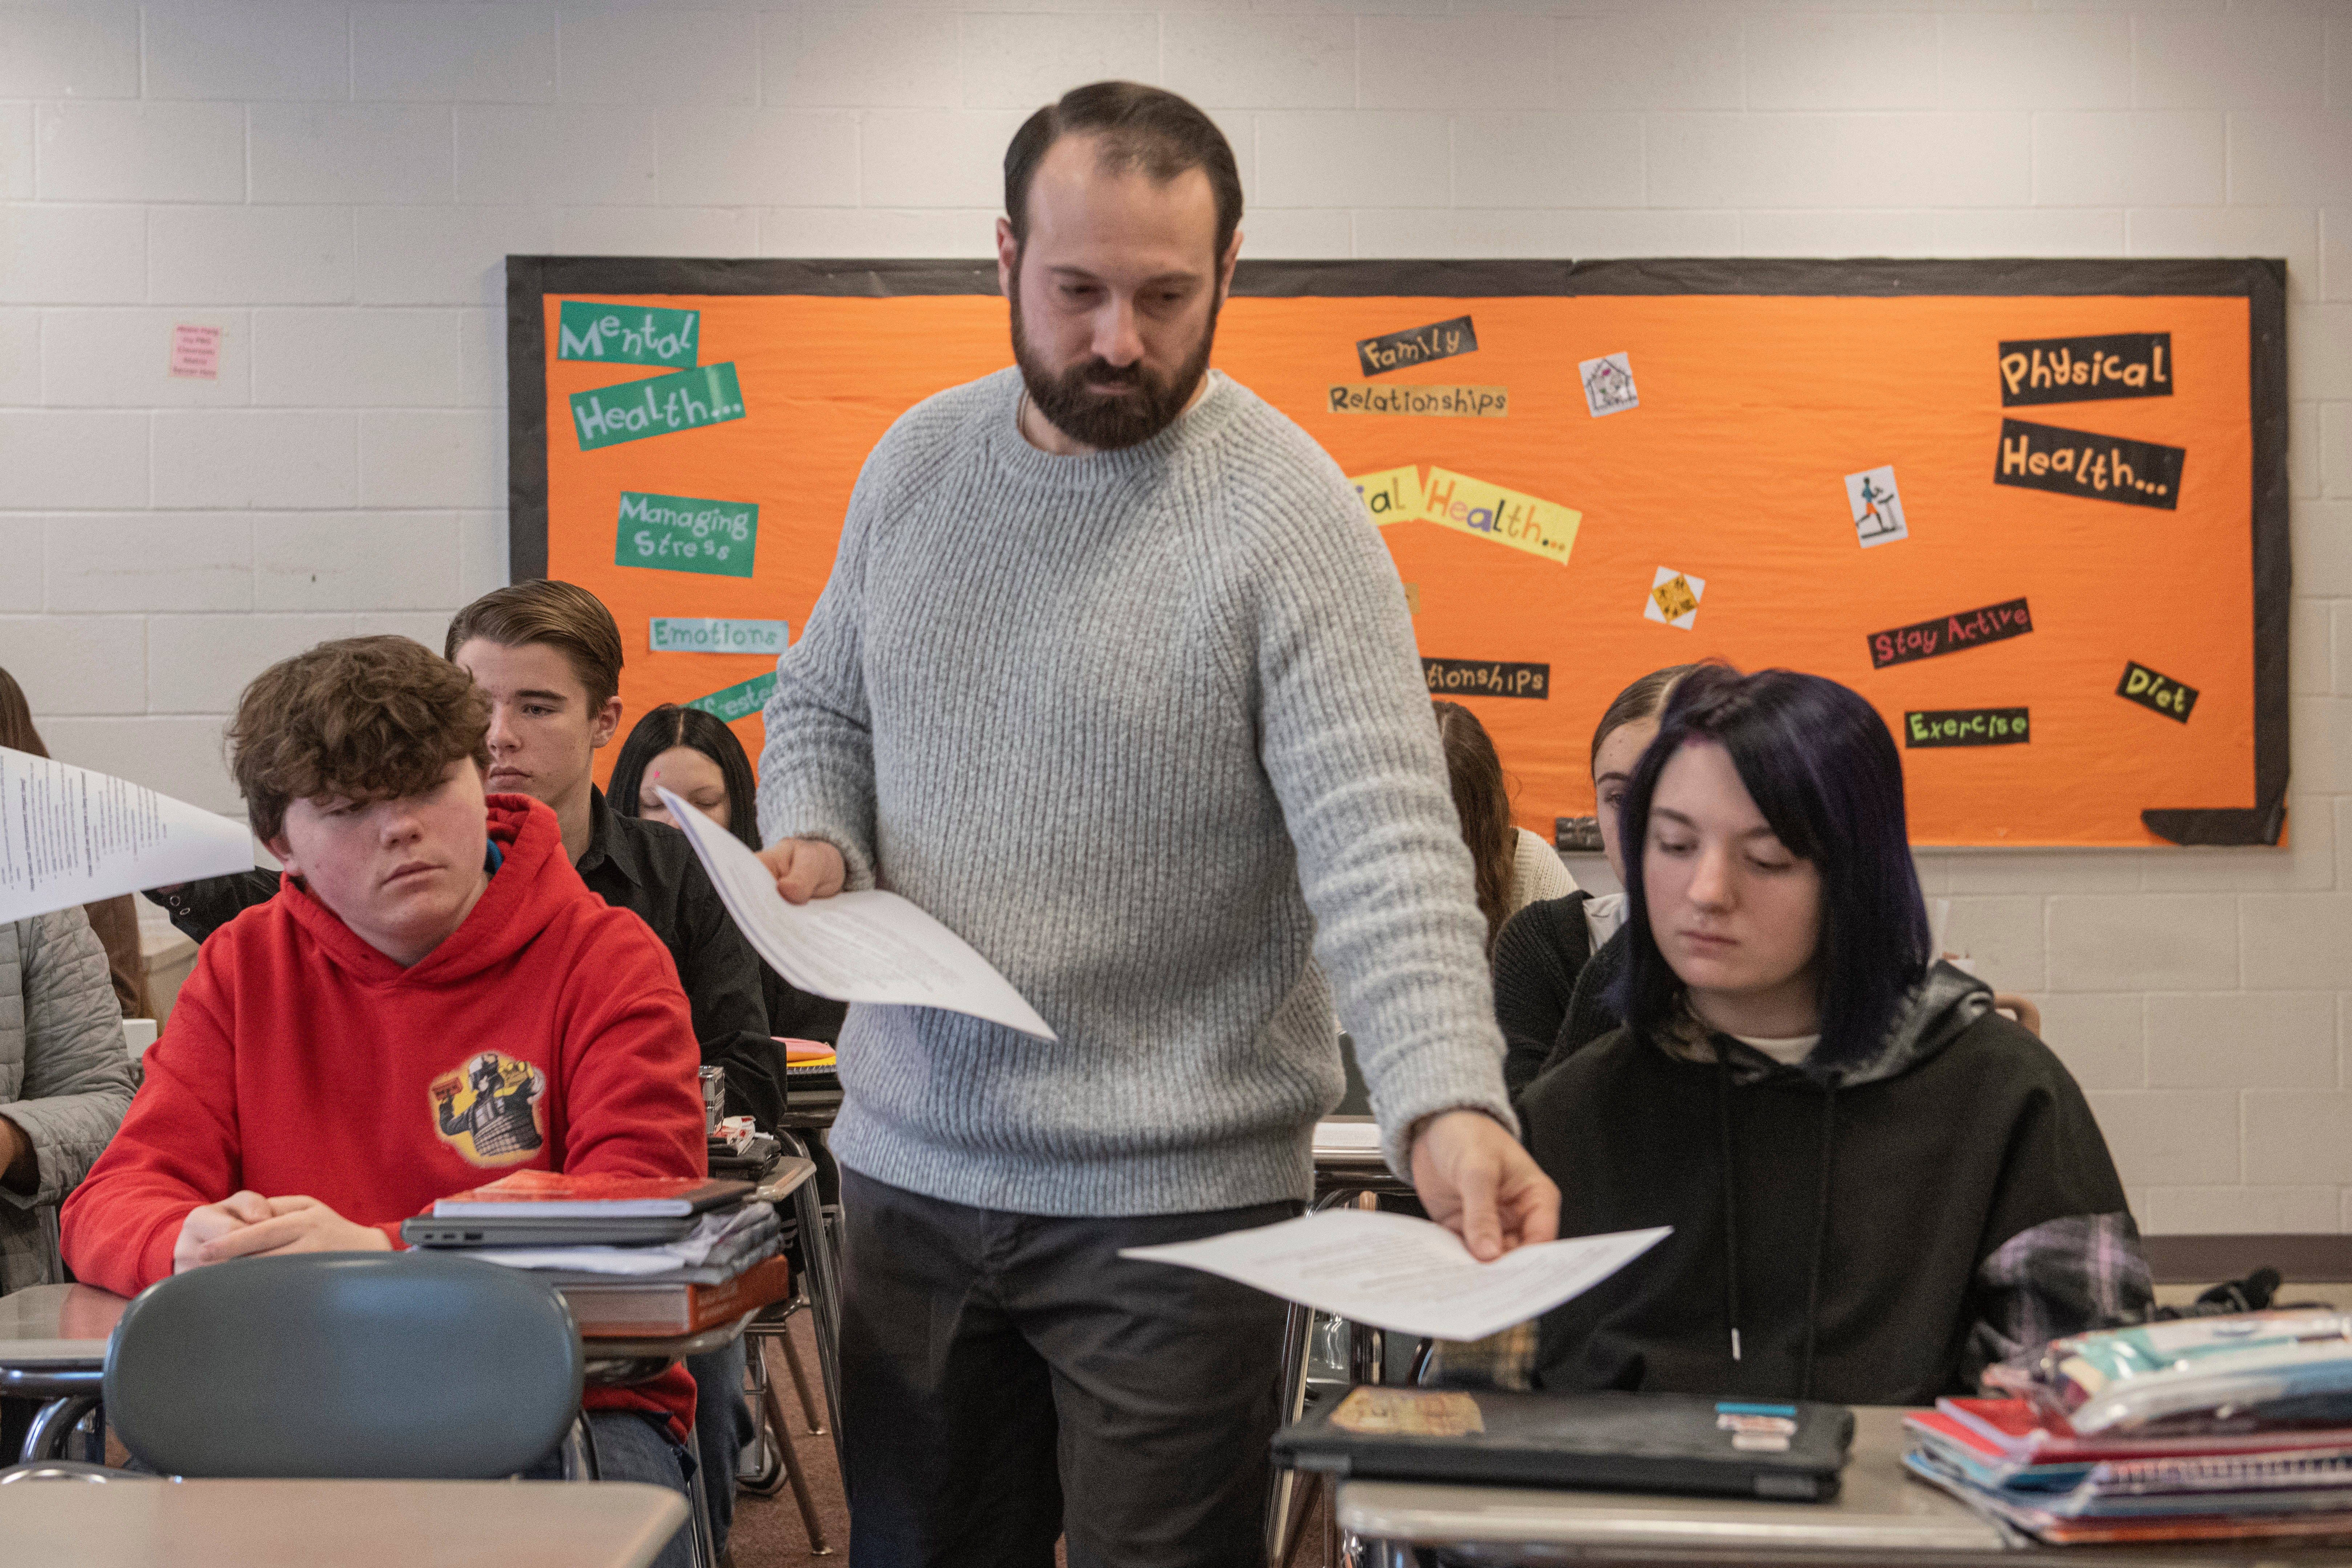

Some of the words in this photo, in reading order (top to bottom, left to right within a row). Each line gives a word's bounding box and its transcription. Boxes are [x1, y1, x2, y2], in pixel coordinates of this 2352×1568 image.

[561, 313, 694, 359] Mental
[1363, 328, 1460, 369] Family
[2000, 345, 2166, 394] Physical
[575, 386, 741, 439] Health...
[1330, 386, 1506, 415] Relationships
[2003, 434, 2167, 496] Health...
[619, 494, 749, 540] Managing
[1426, 479, 1566, 551] Health...
[634, 530, 730, 560] Stress
[653, 619, 777, 646] Emotions
[1875, 626, 1937, 661] Stay
[1948, 606, 2028, 643] Active
[1426, 663, 1544, 694] tionships
[2125, 668, 2185, 713] Diet
[1910, 712, 2026, 741] Exercise
